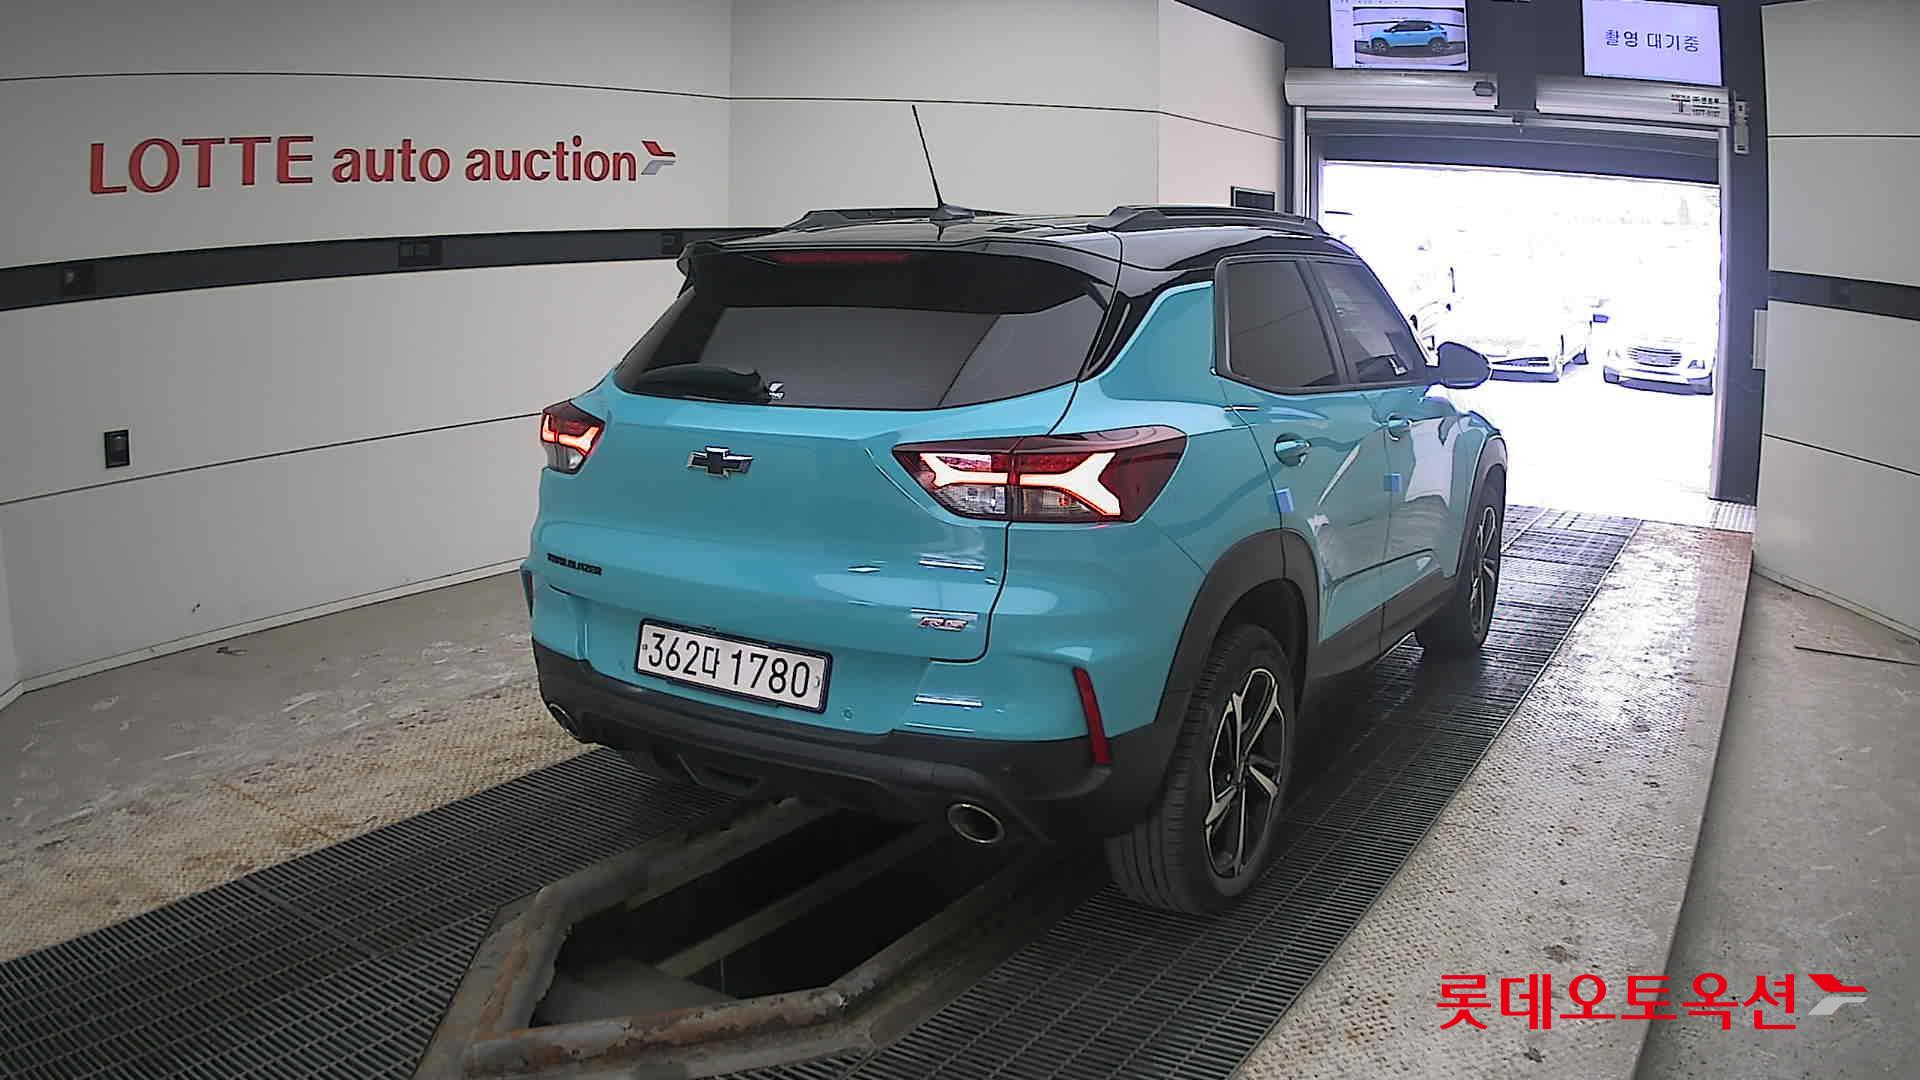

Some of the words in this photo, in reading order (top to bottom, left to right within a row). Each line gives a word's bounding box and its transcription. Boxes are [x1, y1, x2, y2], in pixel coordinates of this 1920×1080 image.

[1646, 33, 1700, 52] 대기중
[90, 135, 314, 194] LOTTE
[332, 137, 450, 184] auto
[464, 135, 638, 182] auction
[648, 632, 720, 679] 362다
[731, 649, 810, 698] 1780
